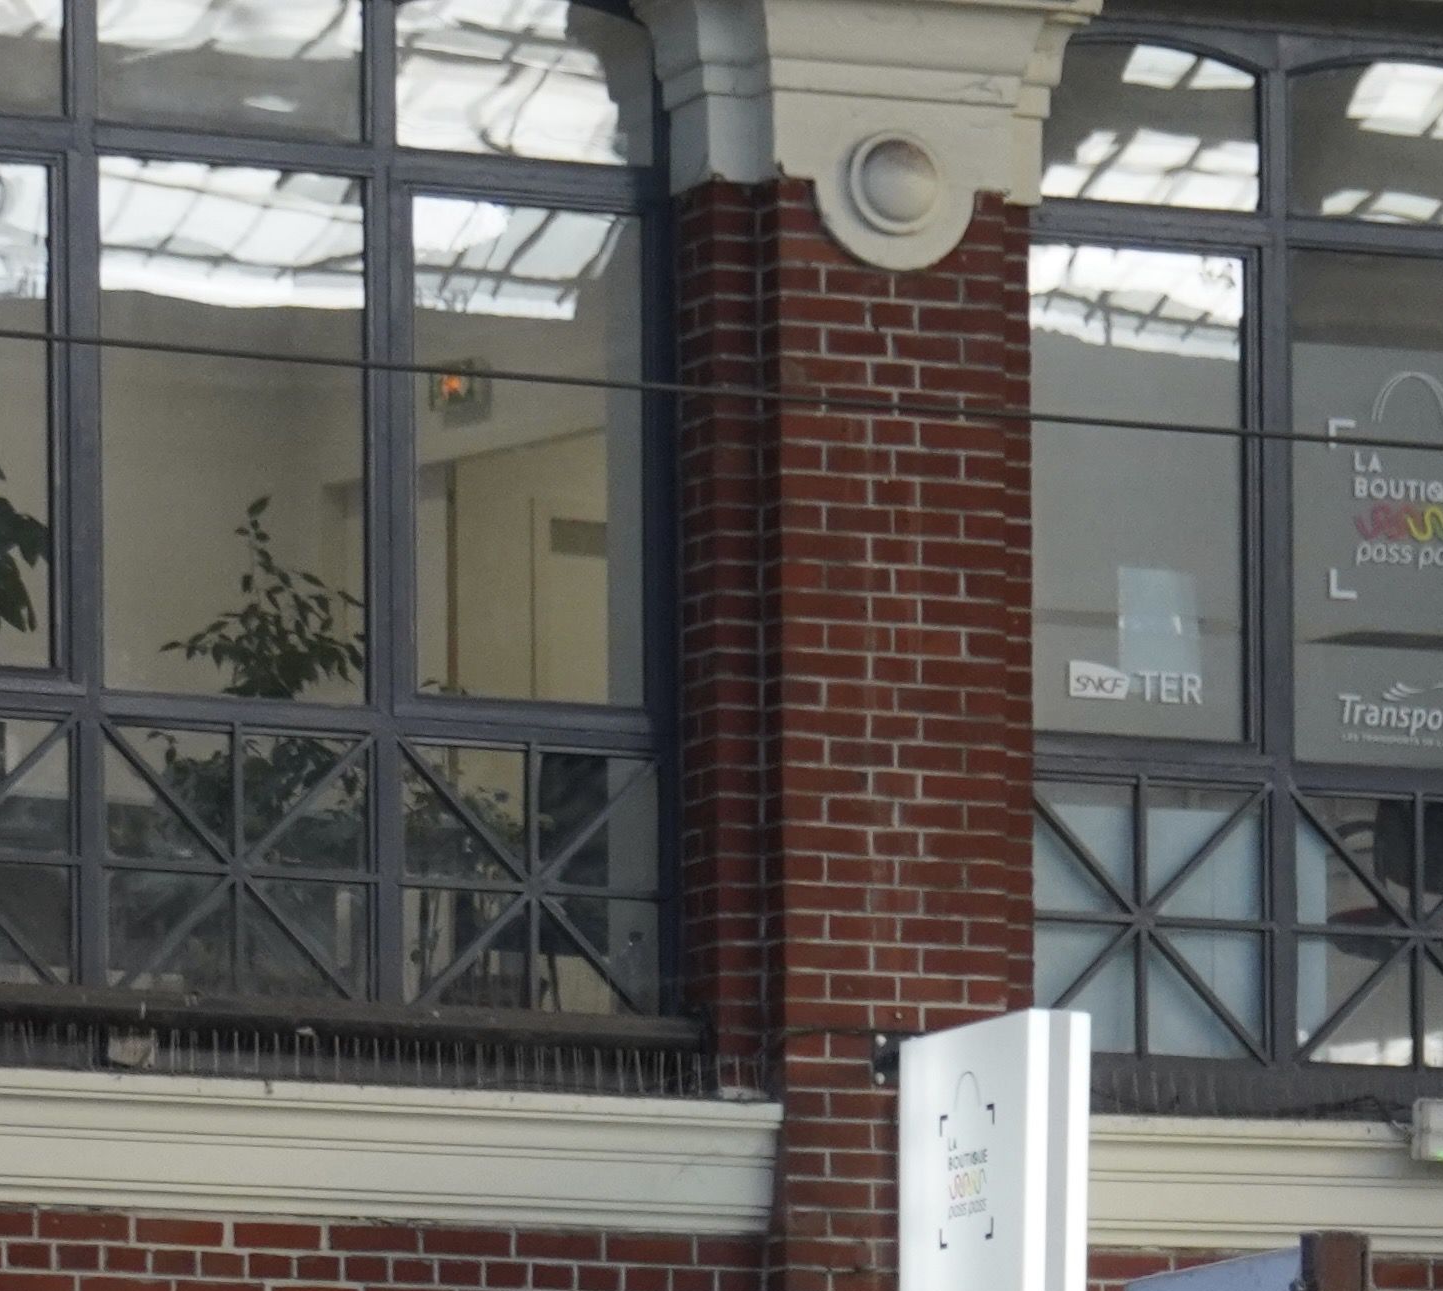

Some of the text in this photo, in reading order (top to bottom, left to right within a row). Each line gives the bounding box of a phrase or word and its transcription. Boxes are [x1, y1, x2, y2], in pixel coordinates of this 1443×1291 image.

[1354, 451, 1382, 473] LA
[1356, 543, 1413, 567] pass
[1139, 670, 1203, 705] TER
